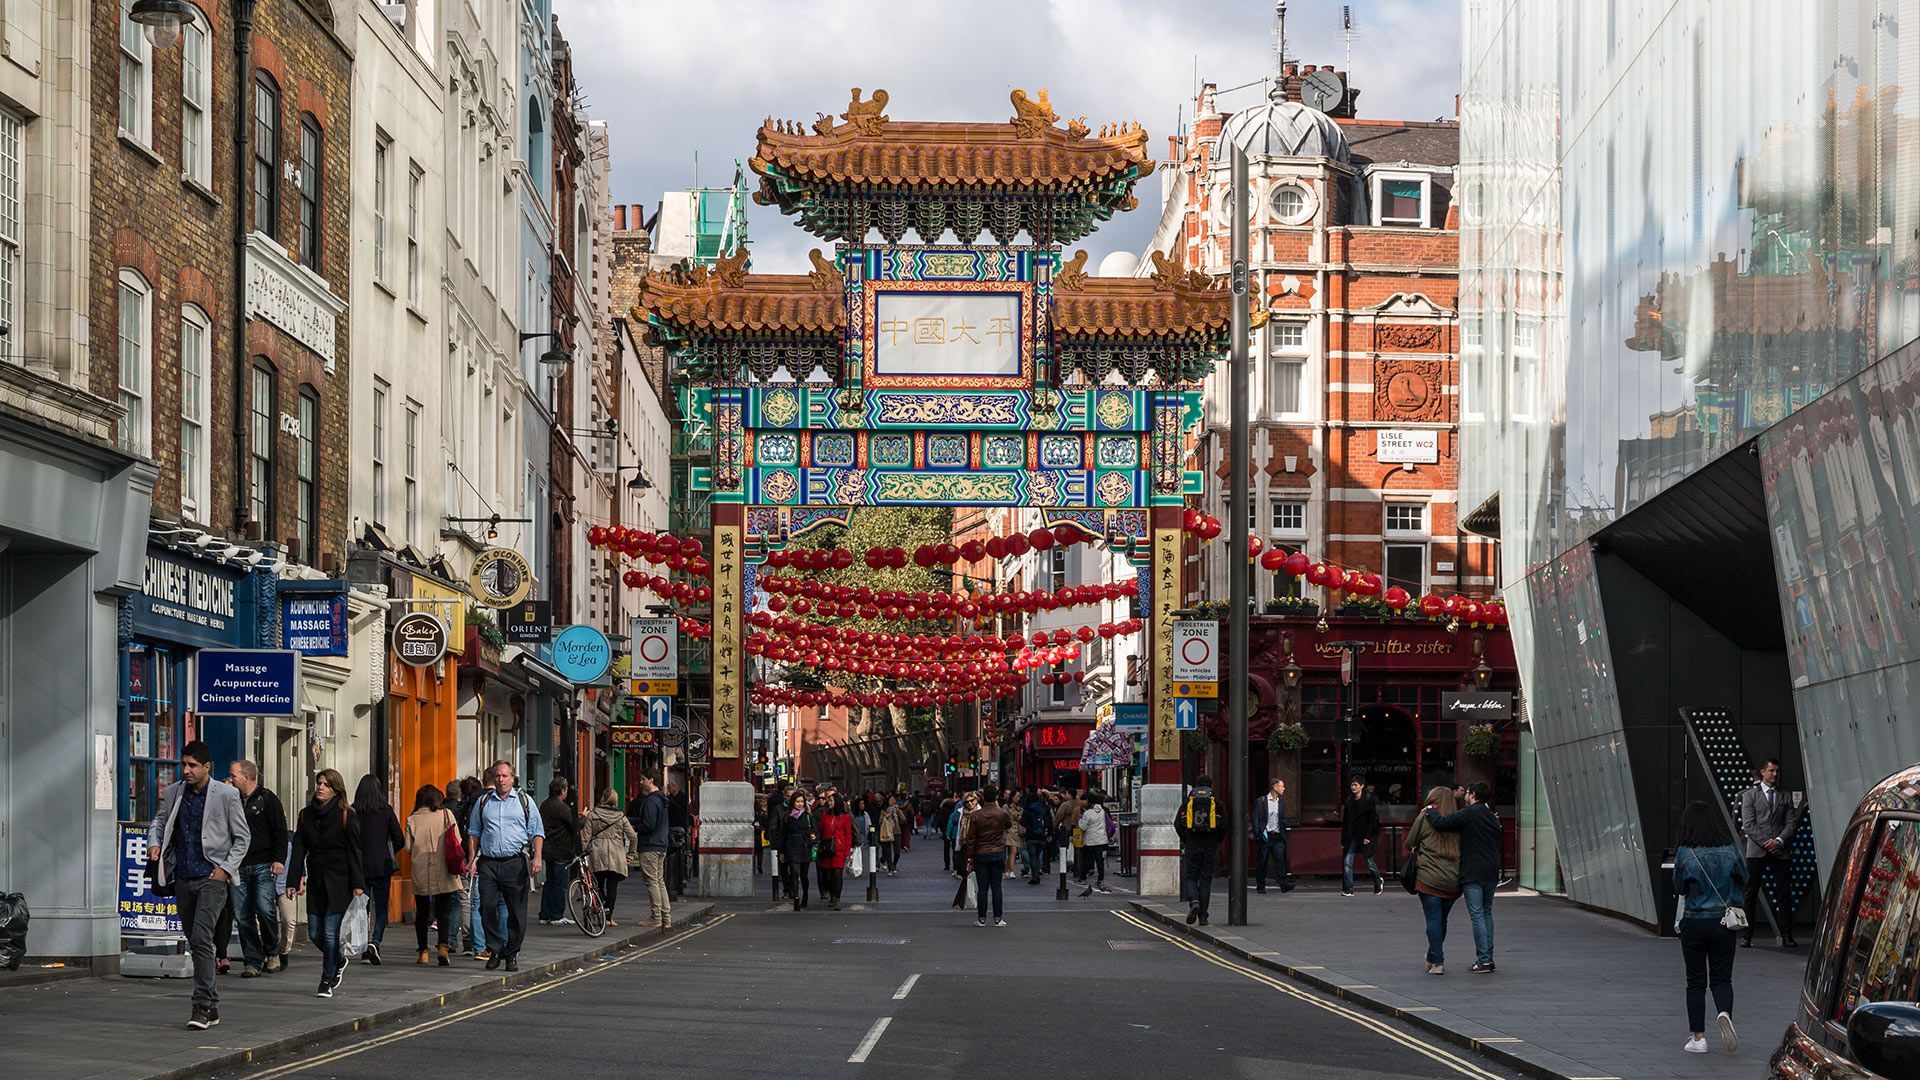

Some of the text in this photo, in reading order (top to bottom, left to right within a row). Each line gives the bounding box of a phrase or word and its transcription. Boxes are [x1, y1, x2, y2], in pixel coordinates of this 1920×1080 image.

[880, 314, 1016, 347] 中國太平
[1381, 432, 1403, 440] LISLE
[1381, 440, 1413, 448] STREET
[472, 550, 529, 583] WAXY O'CONNOR'S
[143, 555, 234, 618] CHINESE MEDICINE
[484, 596, 513, 607] LONDON
[290, 600, 330, 615] ACUPUNCTURE
[151, 603, 186, 620] ACUPUNCTURE
[186, 612, 208, 626] MASSAGE
[290, 620, 330, 631] MASSAGE
[405, 624, 435, 635] Bake
[510, 625, 548, 633] ORIENT
[640, 626, 668, 634] ZONE
[1182, 628, 1209, 637] ZONE
[290, 636, 330, 650] CHINESE MEDICINE
[558, 640, 604, 653] Morden
[403, 642, 437, 656] 麵包屋
[567, 652, 597, 667] & Lea
[225, 663, 268, 675] Massage
[213, 679, 279, 690] Acupuncture
[201, 693, 291, 703] Chinese Medicine
[125, 827, 148, 835] MOBILE
